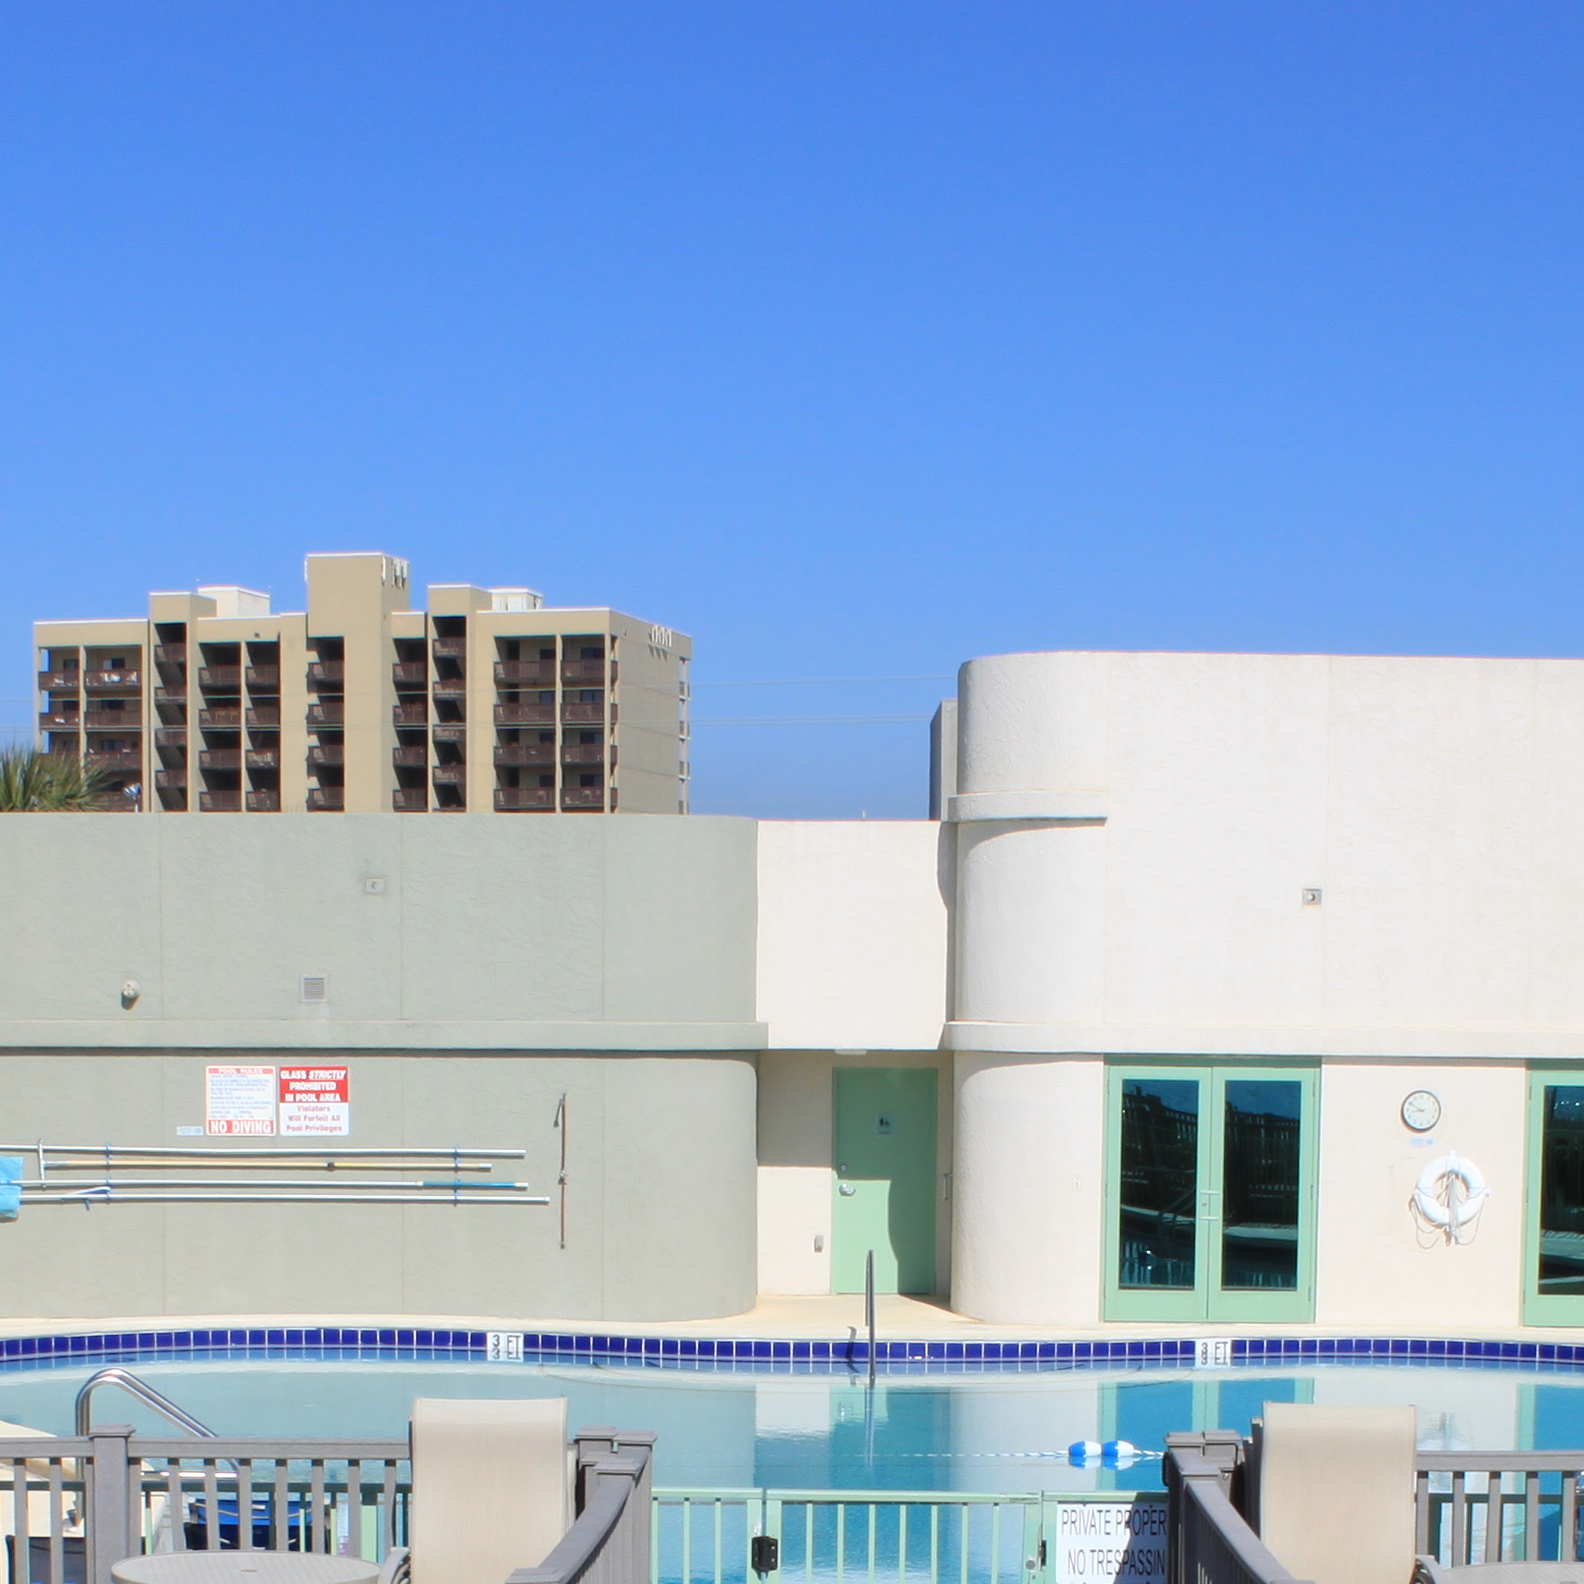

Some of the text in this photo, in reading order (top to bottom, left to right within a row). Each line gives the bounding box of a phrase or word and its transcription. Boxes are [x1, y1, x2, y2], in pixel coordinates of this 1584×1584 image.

[280, 1070, 347, 1080] GLASS STRICTLY
[289, 1082, 337, 1090] PROHIBITED
[285, 1093, 341, 1101] IN POOL AREA
[210, 1121, 227, 1133] NO
[232, 1121, 271, 1133] DIVING
[1061, 1509, 1167, 1535] PRIVATE PROPER
[1067, 1549, 1166, 1576] NO TRESPASSIN
